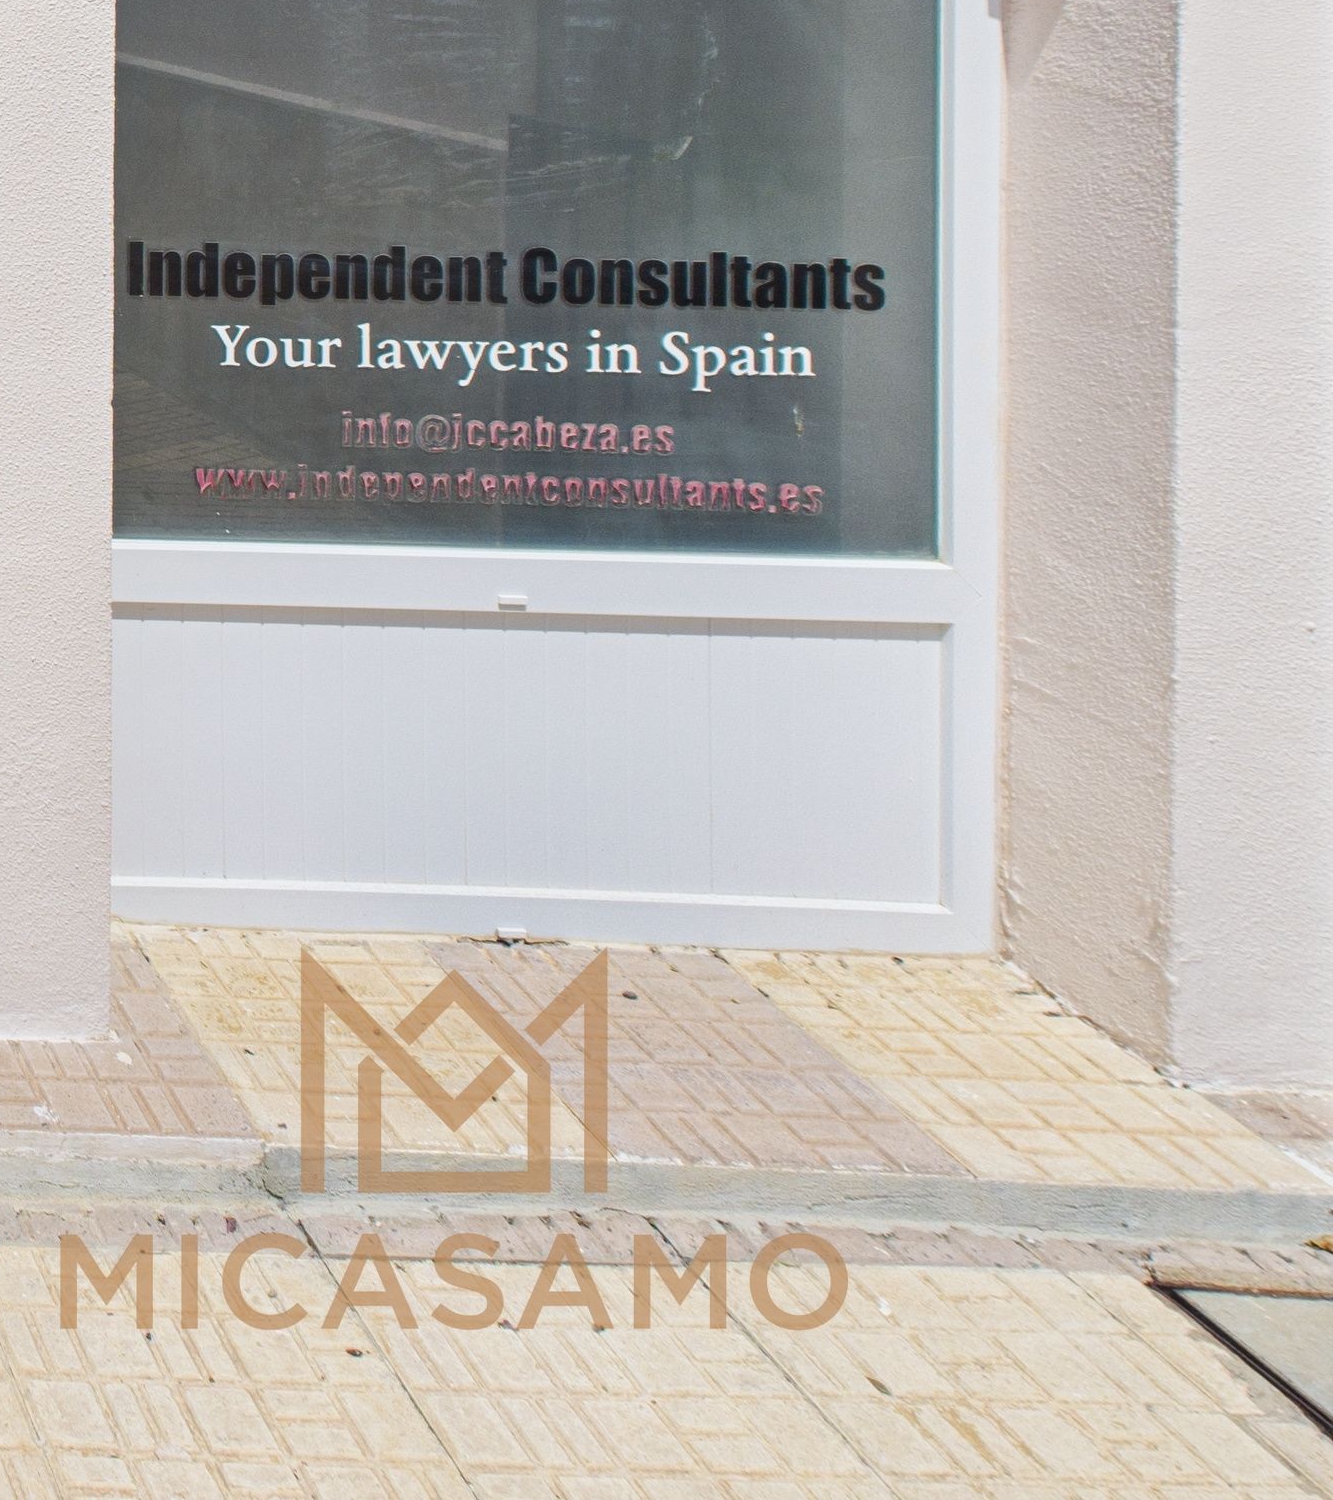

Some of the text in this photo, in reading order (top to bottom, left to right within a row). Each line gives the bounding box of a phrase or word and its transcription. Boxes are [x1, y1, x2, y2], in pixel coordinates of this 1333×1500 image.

[127, 240, 887, 312] Independent Consultants
[210, 323, 817, 392] Your lawyers in Spain
[341, 410, 675, 455] info@jccabeza.es
